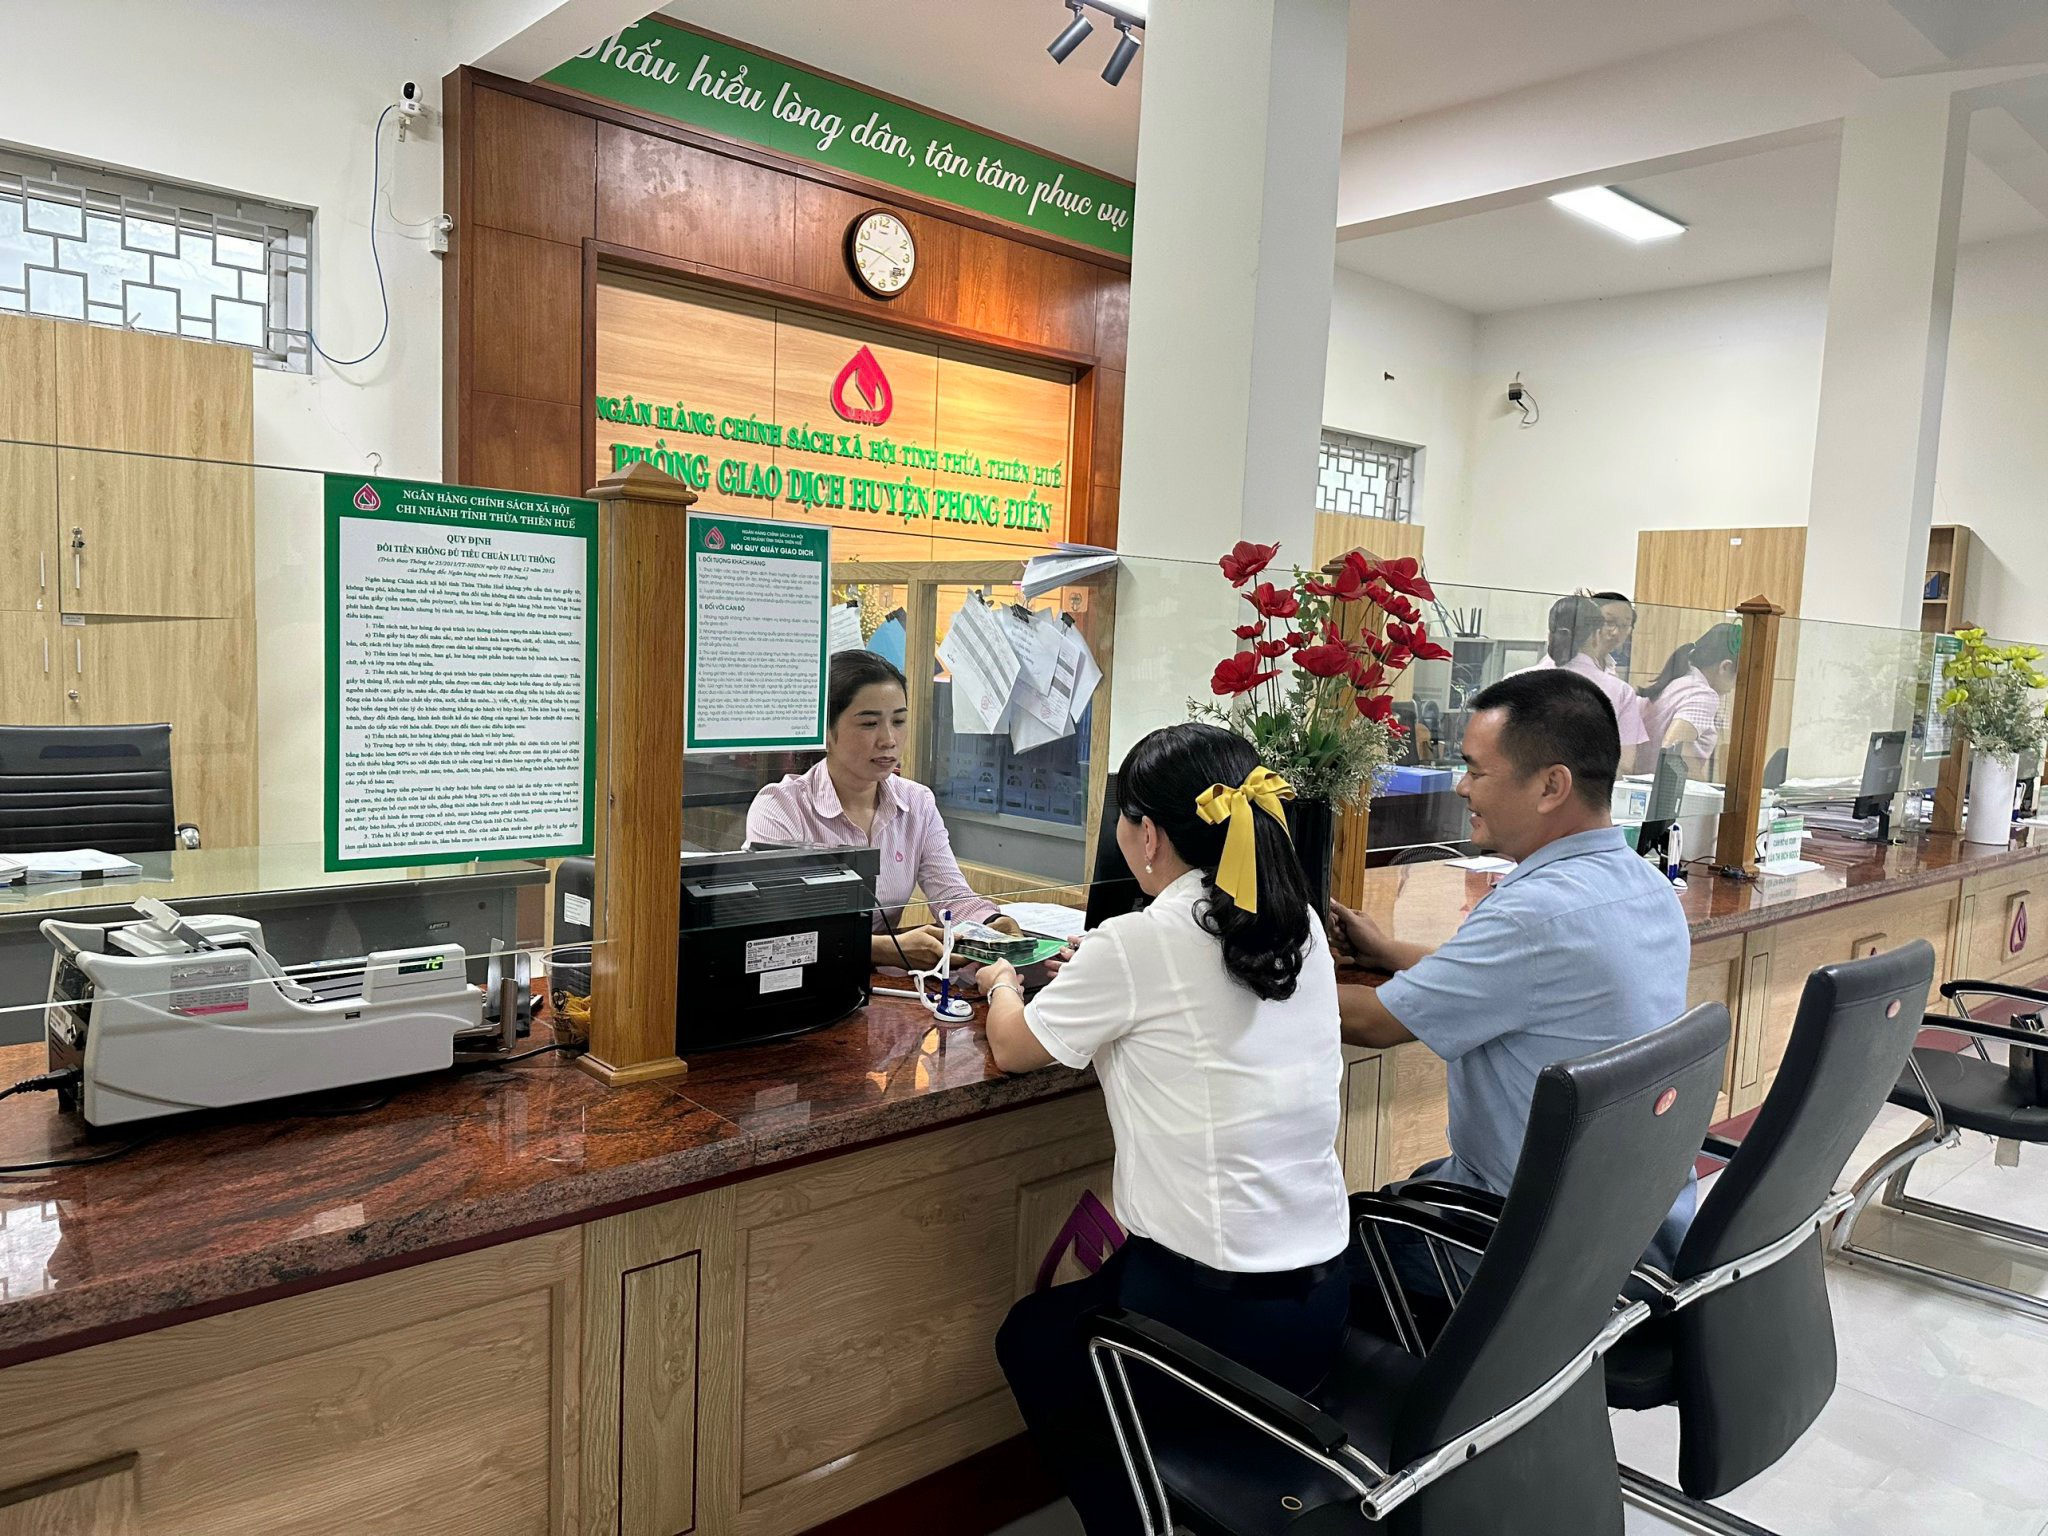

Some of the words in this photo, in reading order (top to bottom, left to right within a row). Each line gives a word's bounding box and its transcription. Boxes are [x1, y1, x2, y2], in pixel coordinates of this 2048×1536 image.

[688, 54, 766, 112] hiểu
[772, 82, 845, 151] lòng
[850, 112, 917, 166] dân,
[924, 140, 974, 177] tận
[976, 158, 1029, 196] tâm
[1028, 174, 1092, 216] phục
[1098, 204, 1129, 230] vụ
[900, 240, 908, 250] 2
[903, 254, 910, 263] 3
[596, 394, 652, 425] NGÂN
[657, 400, 716, 434] HÀNG
[720, 413, 783, 446] CHÍNH
[788, 423, 834, 454] SÁCH
[838, 433, 864, 458] XÃ
[869, 438, 897, 466] HỘI
[988, 458, 1030, 482] THIÊN
[1033, 460, 1063, 487] HUẾ
[403, 490, 434, 501] NGÂN
[437, 493, 467, 504] HÀNG
[470, 496, 504, 508] CHÍNH
[507, 499, 533, 511] SÁCH
[536, 502, 549, 512] XÃ
[552, 504, 569, 516] HỘI
[718, 459, 783, 498] GIAO
[788, 468, 846, 512] DỊCH
[851, 476, 930, 522] HUYỆN
[934, 489, 1000, 525] PHONG
[1006, 488, 1053, 530] ĐIỀN
[396, 504, 416, 514] CHI
[419, 506, 458, 518] NHÁNH
[461, 508, 486, 520] TỈNH
[489, 512, 518, 523] THỪA
[520, 515, 551, 526] THIÊN
[555, 518, 575, 528] HUẾ
[447, 535, 465, 544] QUY
[468, 536, 491, 546] ĐỊNH
[395, 544, 413, 553] TIỀN
[416, 546, 446, 555] KHÔNG
[448, 548, 458, 557] ĐỦ
[462, 549, 479, 558] TIÊU
[481, 552, 509, 560] CHUẨN
[511, 554, 526, 562] LƯU
[529, 555, 555, 564] THÔNG
